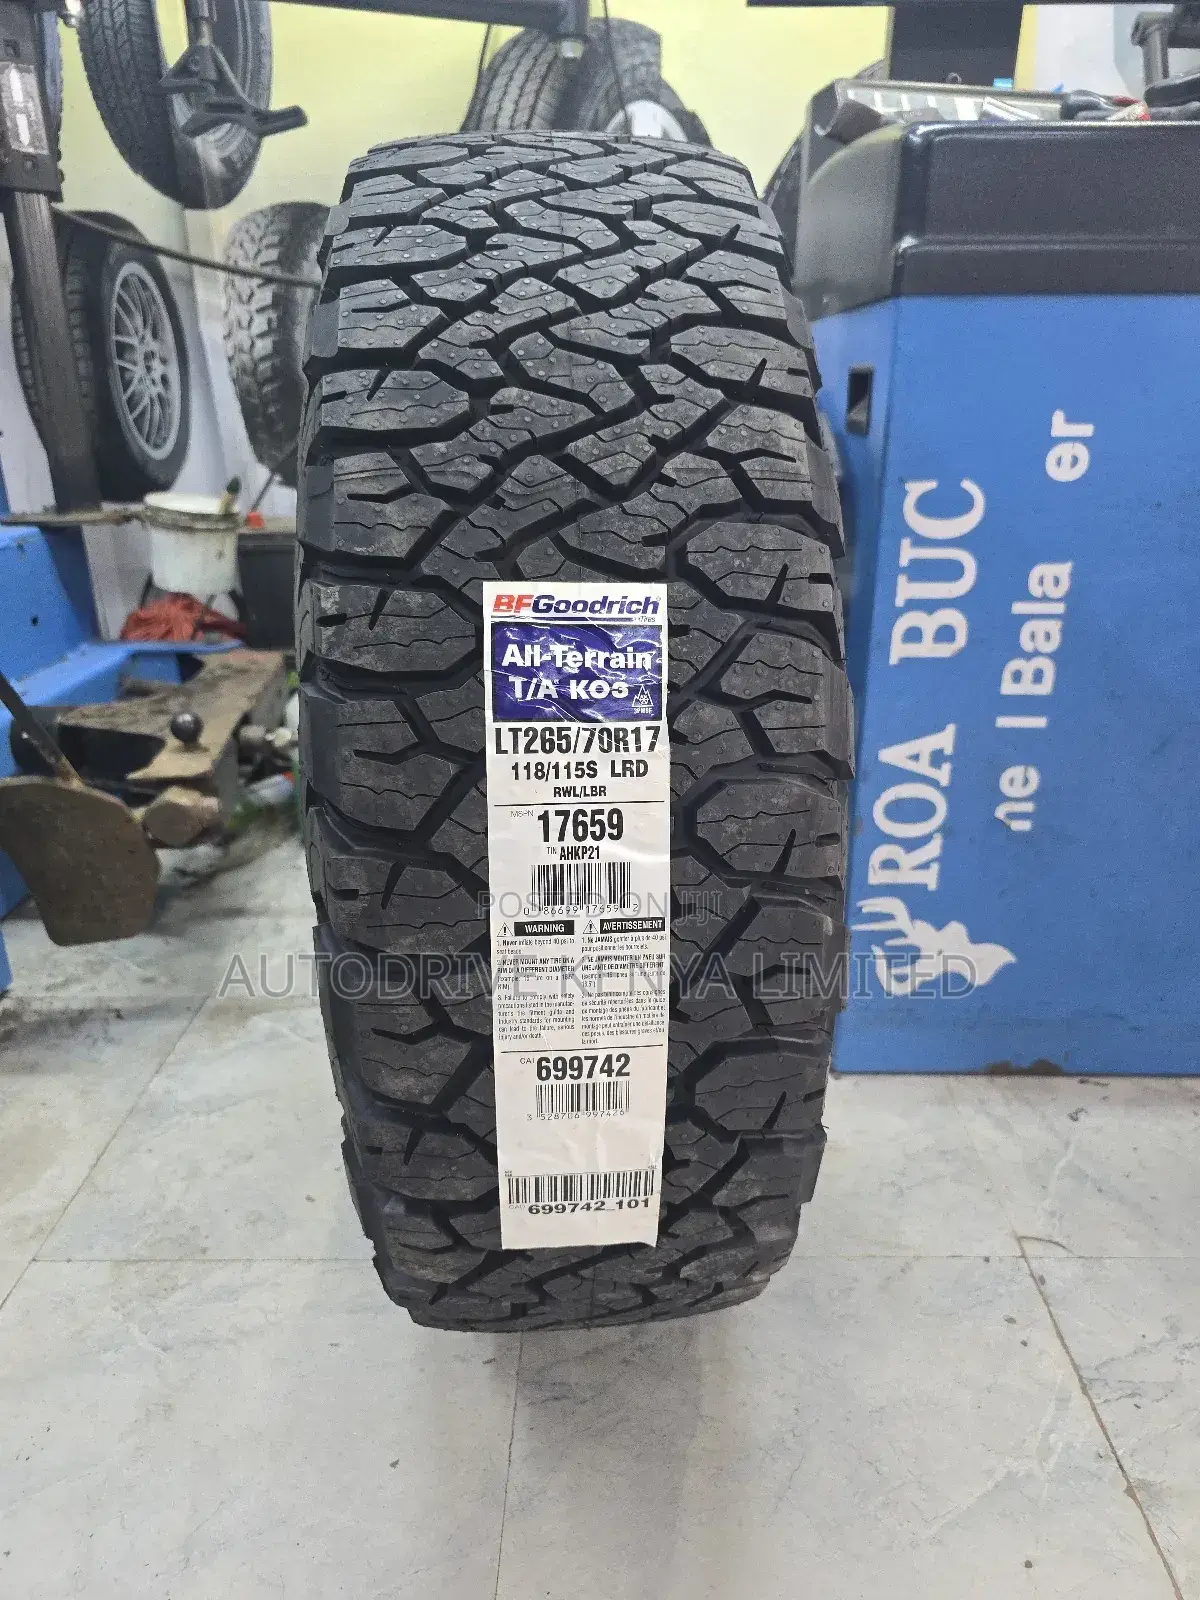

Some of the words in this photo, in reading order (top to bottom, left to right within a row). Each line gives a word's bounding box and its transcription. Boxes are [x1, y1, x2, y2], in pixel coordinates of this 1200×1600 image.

[888, 478, 985, 666] BUC
[492, 594, 659, 614] BFGoodrich
[1000, 561, 1073, 696] Bala
[501, 644, 652, 669] All-Terrain
[509, 676, 558, 700] T/A
[570, 679, 629, 700] KO3
[495, 726, 661, 754] LT265/70R17
[511, 761, 598, 782] 118/115S
[610, 760, 648, 777] LRD
[553, 785, 607, 798] RWL/LBR
[538, 808, 624, 842] 17659
[559, 846, 600, 860] AHKP21
[586, 904, 619, 913] 17659
[525, 923, 565, 933] WARNING
[602, 920, 663, 931] AVERTISSEMENT
[520, 1057, 535, 1065] CAI
[536, 1053, 631, 1081] 699742
[585, 1109, 625, 1118] 997426
[528, 1197, 649, 1214] 699742_101
